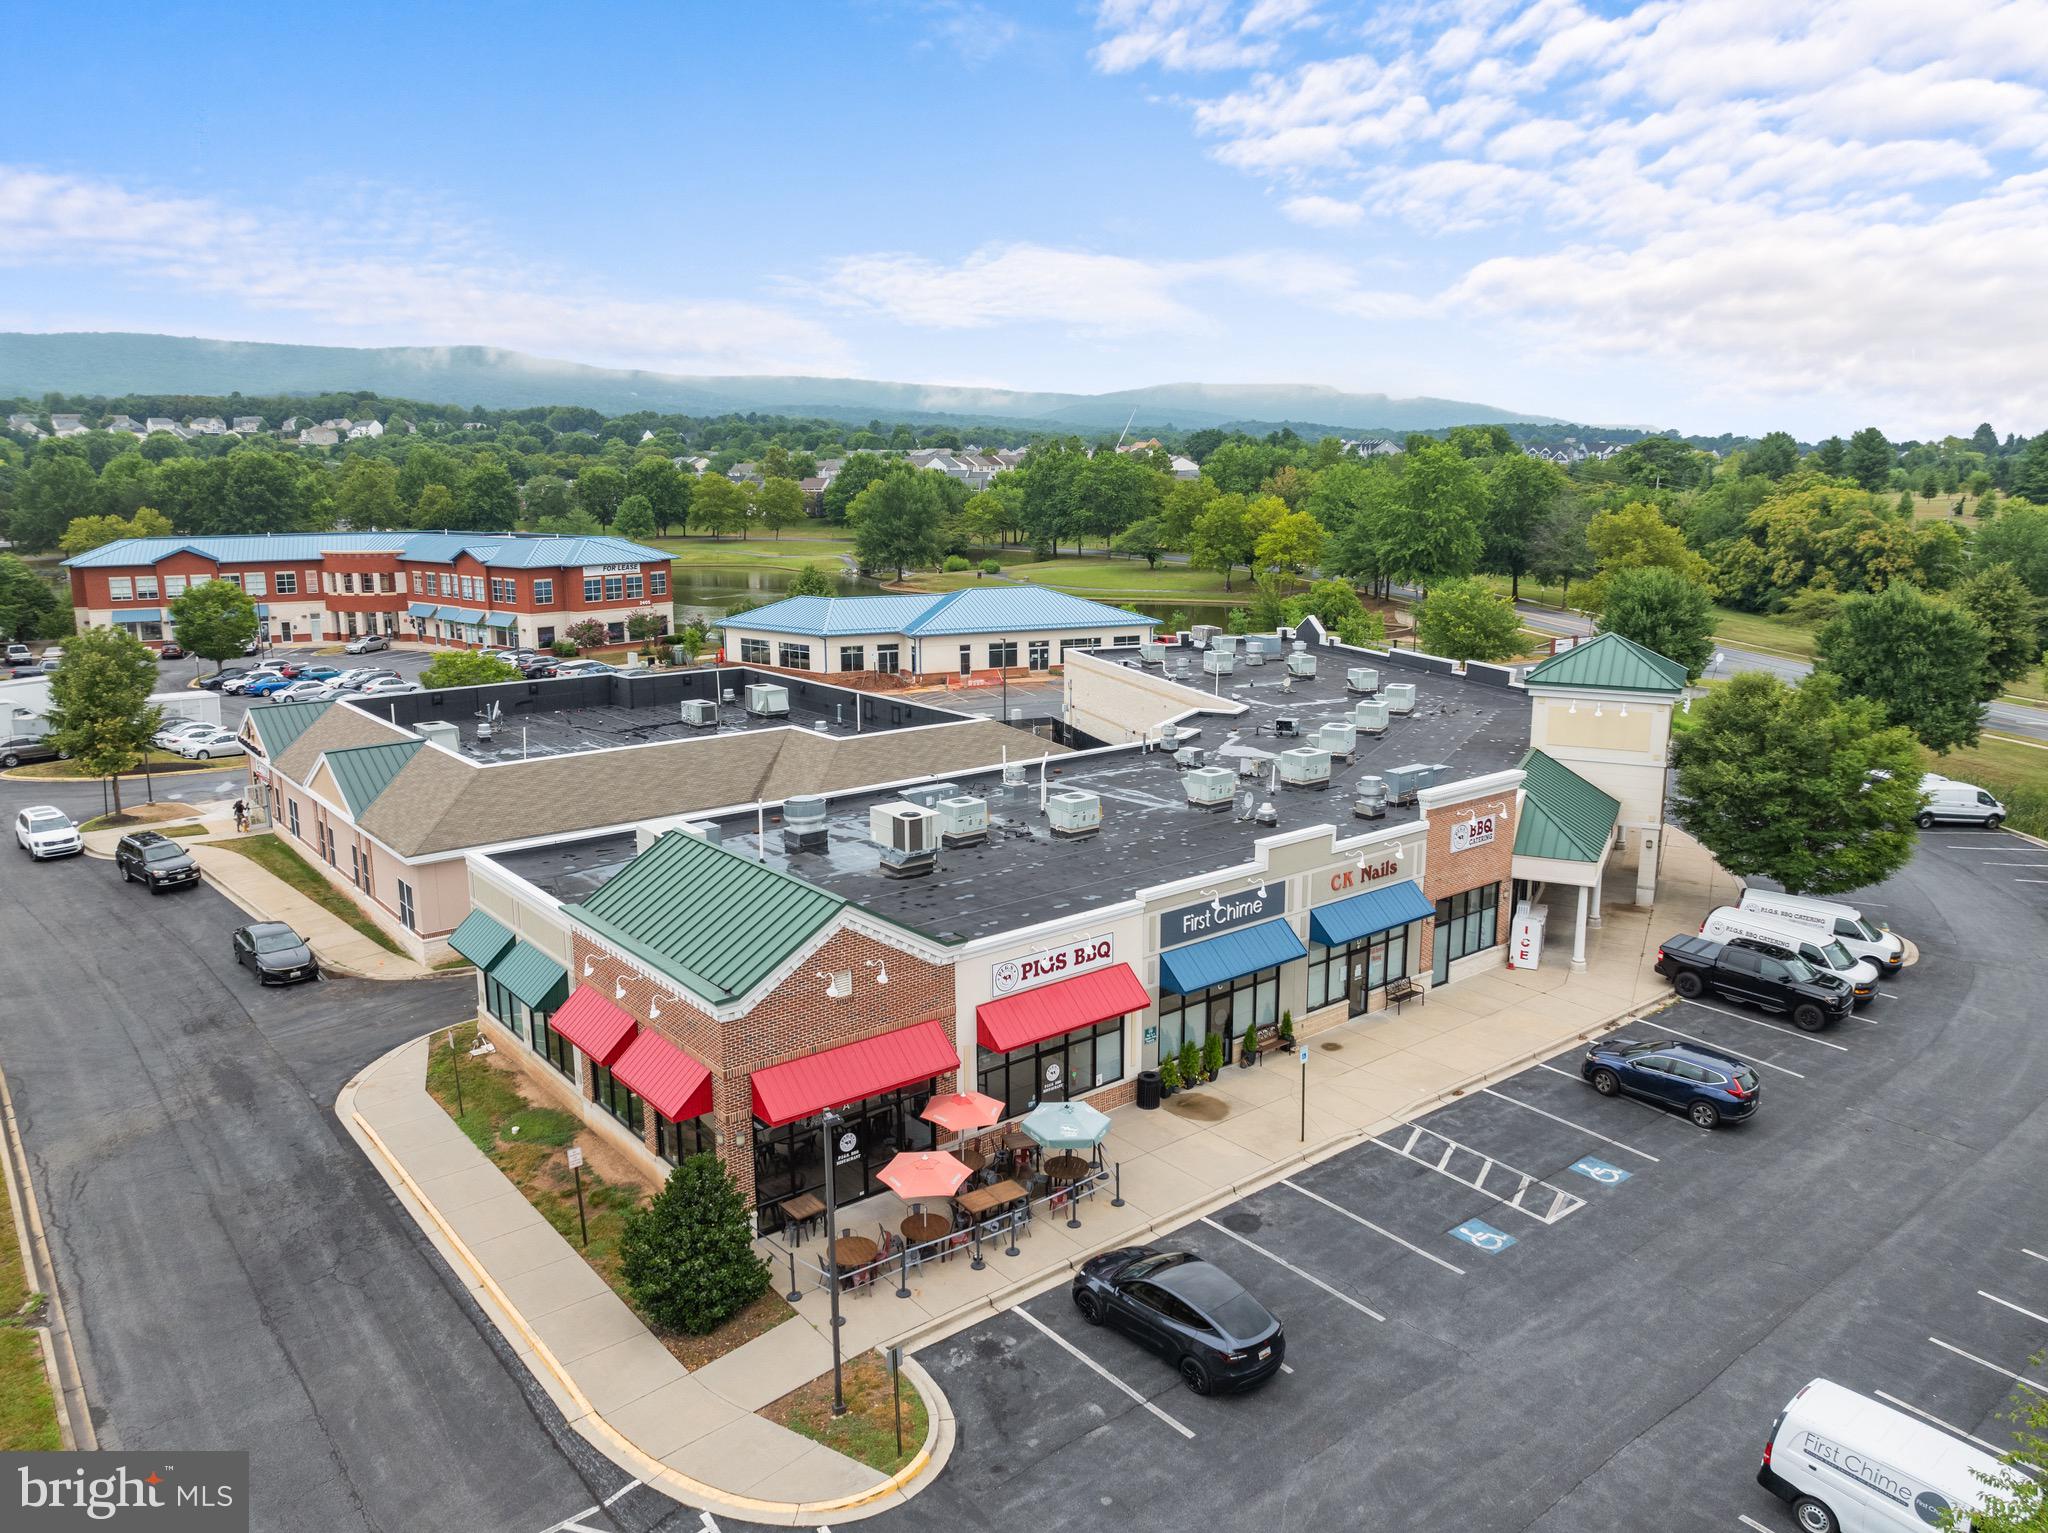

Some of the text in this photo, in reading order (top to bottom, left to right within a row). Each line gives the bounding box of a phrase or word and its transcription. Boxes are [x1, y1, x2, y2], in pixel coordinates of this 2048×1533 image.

[603, 563, 638, 572] FOR LEASE
[1470, 818, 1493, 837] BBQ
[1331, 860, 1398, 891] CK Nails
[1183, 899, 1263, 933] First Chime
[1794, 913, 1826, 925] CATERING
[1520, 926, 1530, 960] ICE
[1759, 935, 1790, 948] CATERING
[1021, 941, 1111, 981] PIGS BBQ
[1804, 1432, 1840, 1463] First
[1844, 1455, 1912, 1500] Chime
